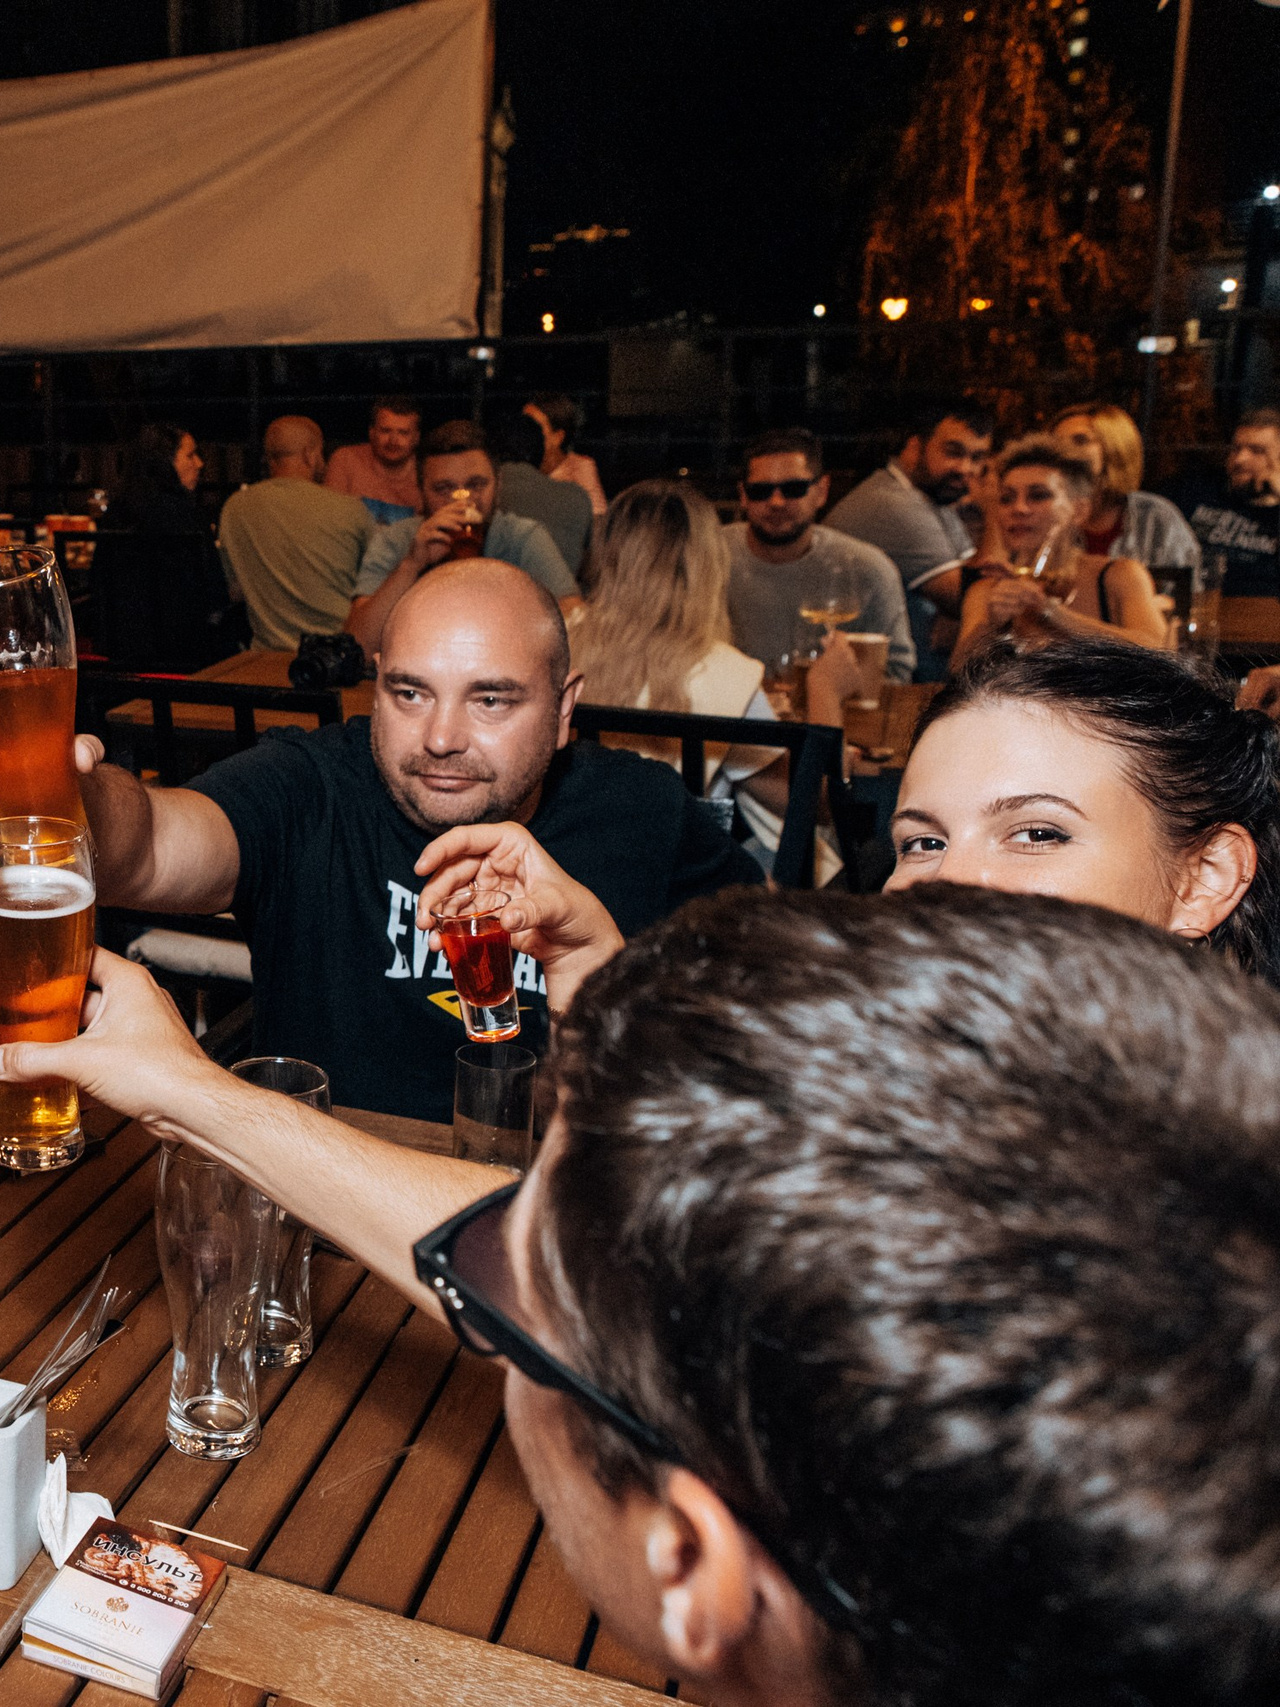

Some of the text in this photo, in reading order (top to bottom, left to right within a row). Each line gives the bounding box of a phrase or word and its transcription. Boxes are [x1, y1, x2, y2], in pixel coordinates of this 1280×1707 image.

[93, 1537, 202, 1583] ИНСУЛЬТ
[70, 1601, 145, 1636] SOBRANIE
[52, 1654, 126, 1684] SOBRANIE COLOURS
